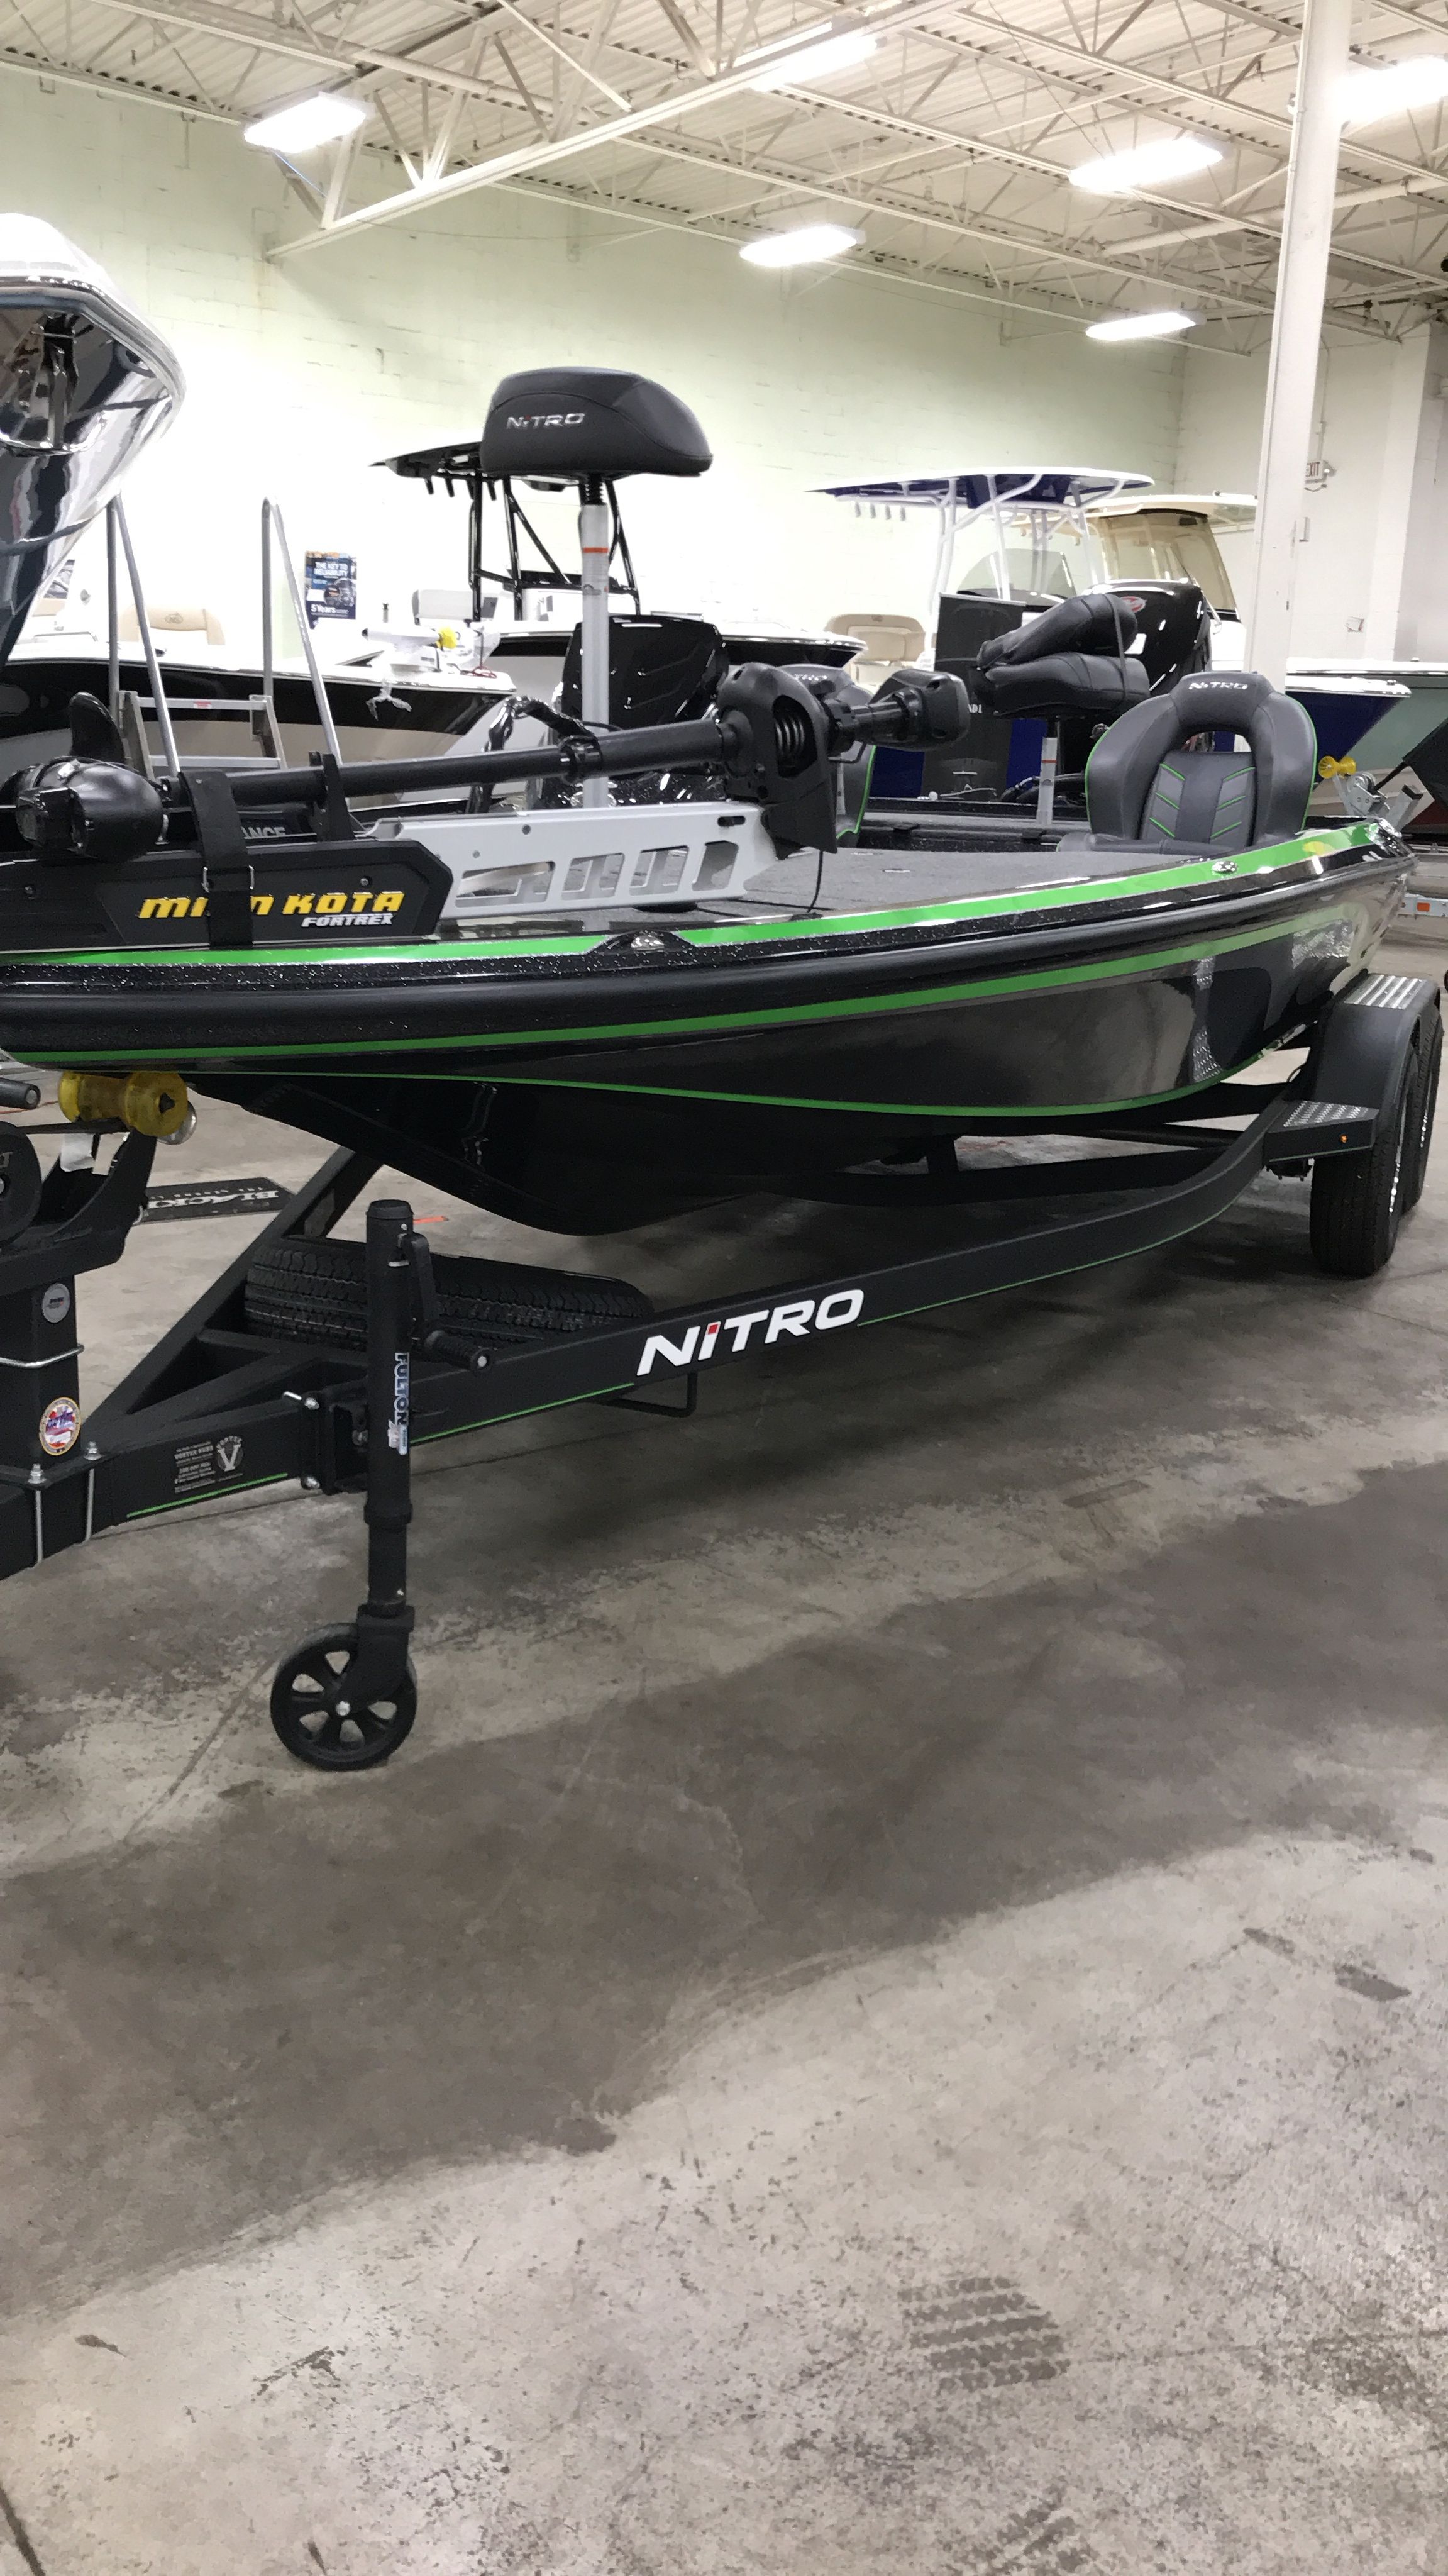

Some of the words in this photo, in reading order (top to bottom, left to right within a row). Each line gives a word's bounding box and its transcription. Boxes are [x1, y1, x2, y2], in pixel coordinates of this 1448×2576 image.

[138, 896, 275, 919] MIN
[282, 891, 405, 914] KOTA
[301, 913, 394, 928] FORTREX
[394, 1352, 410, 1426] FULTON
